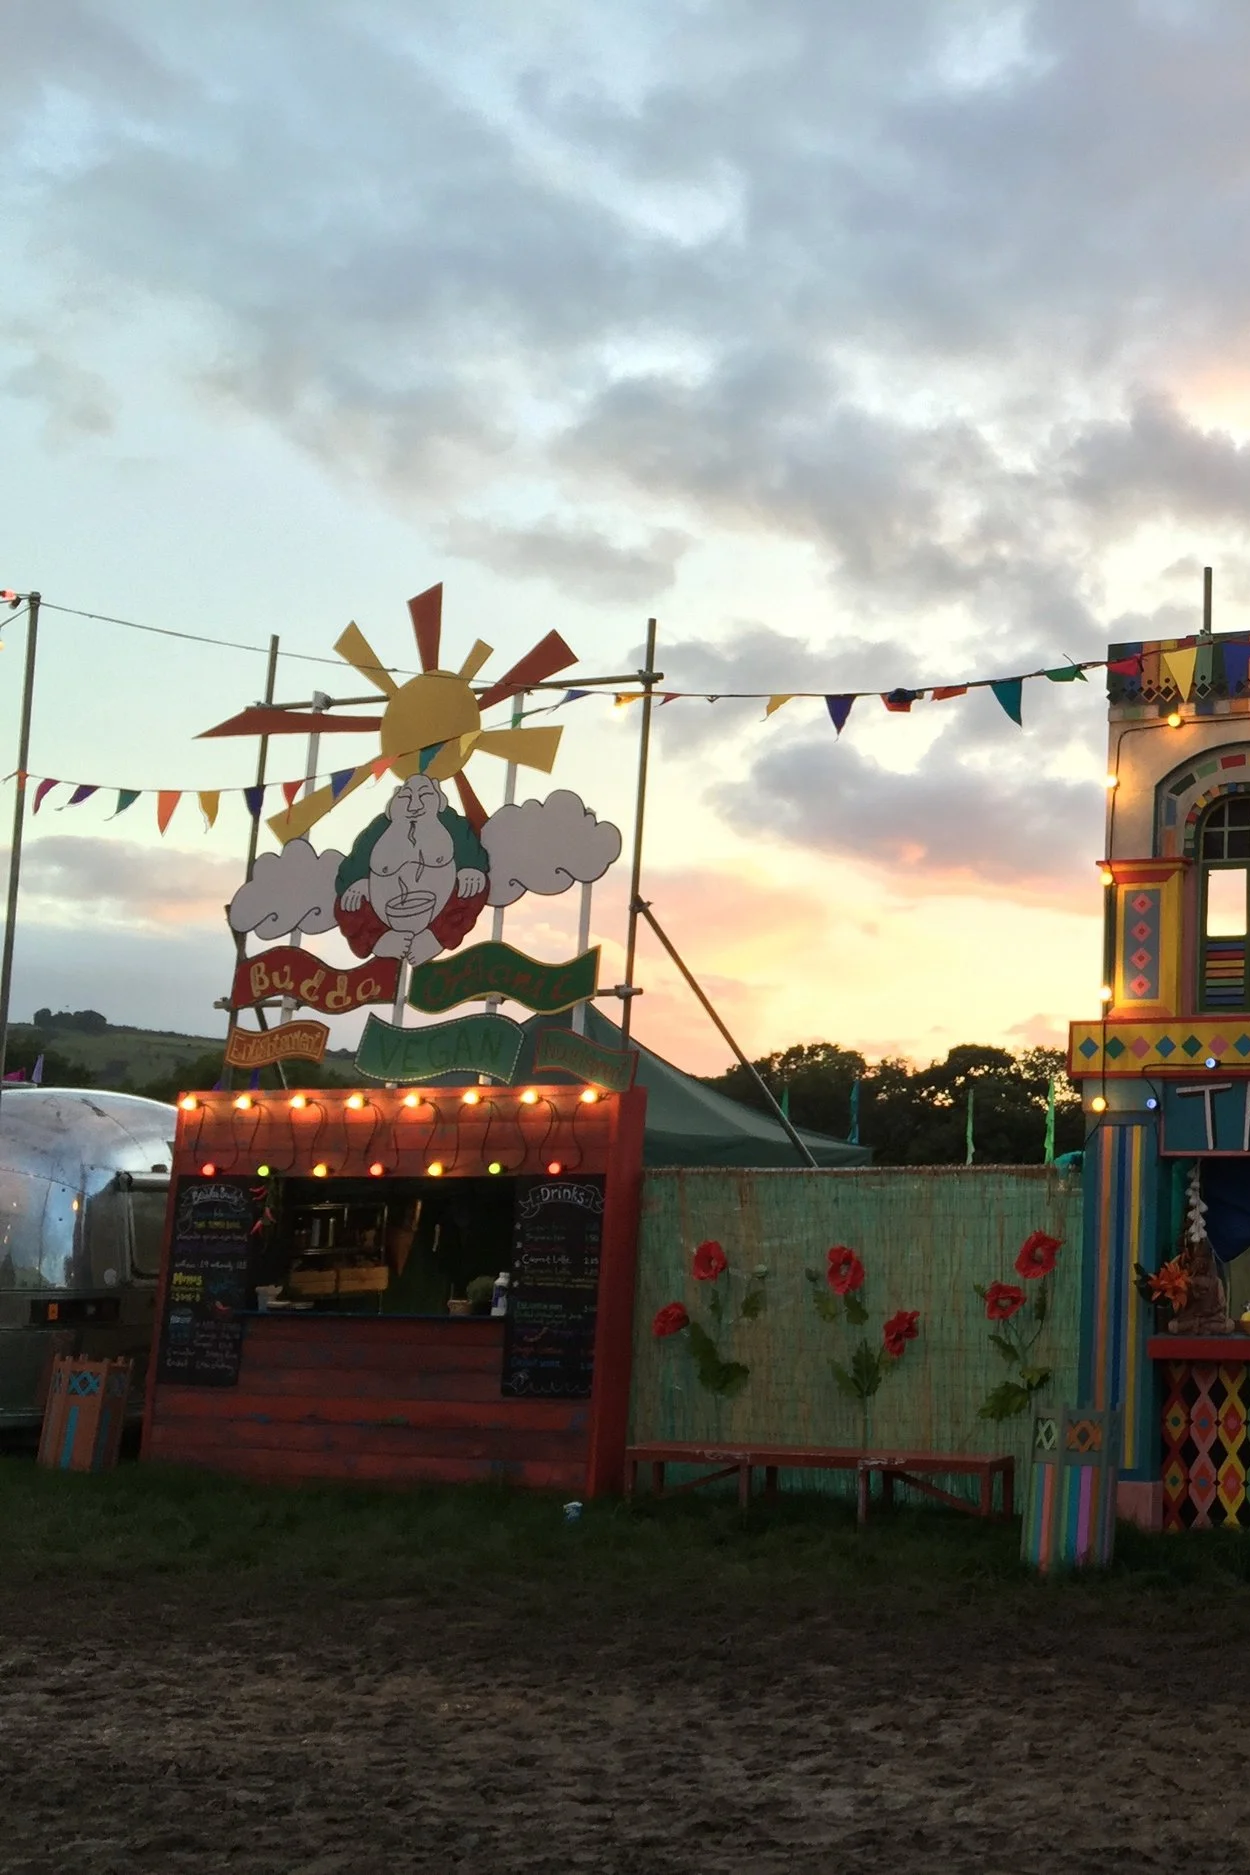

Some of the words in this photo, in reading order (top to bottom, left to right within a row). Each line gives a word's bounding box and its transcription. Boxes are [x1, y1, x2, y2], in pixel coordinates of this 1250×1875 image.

[250, 961, 381, 1009] Budda
[378, 1027, 502, 1074] VEGAN
[540, 1186, 585, 1206] Drinks
